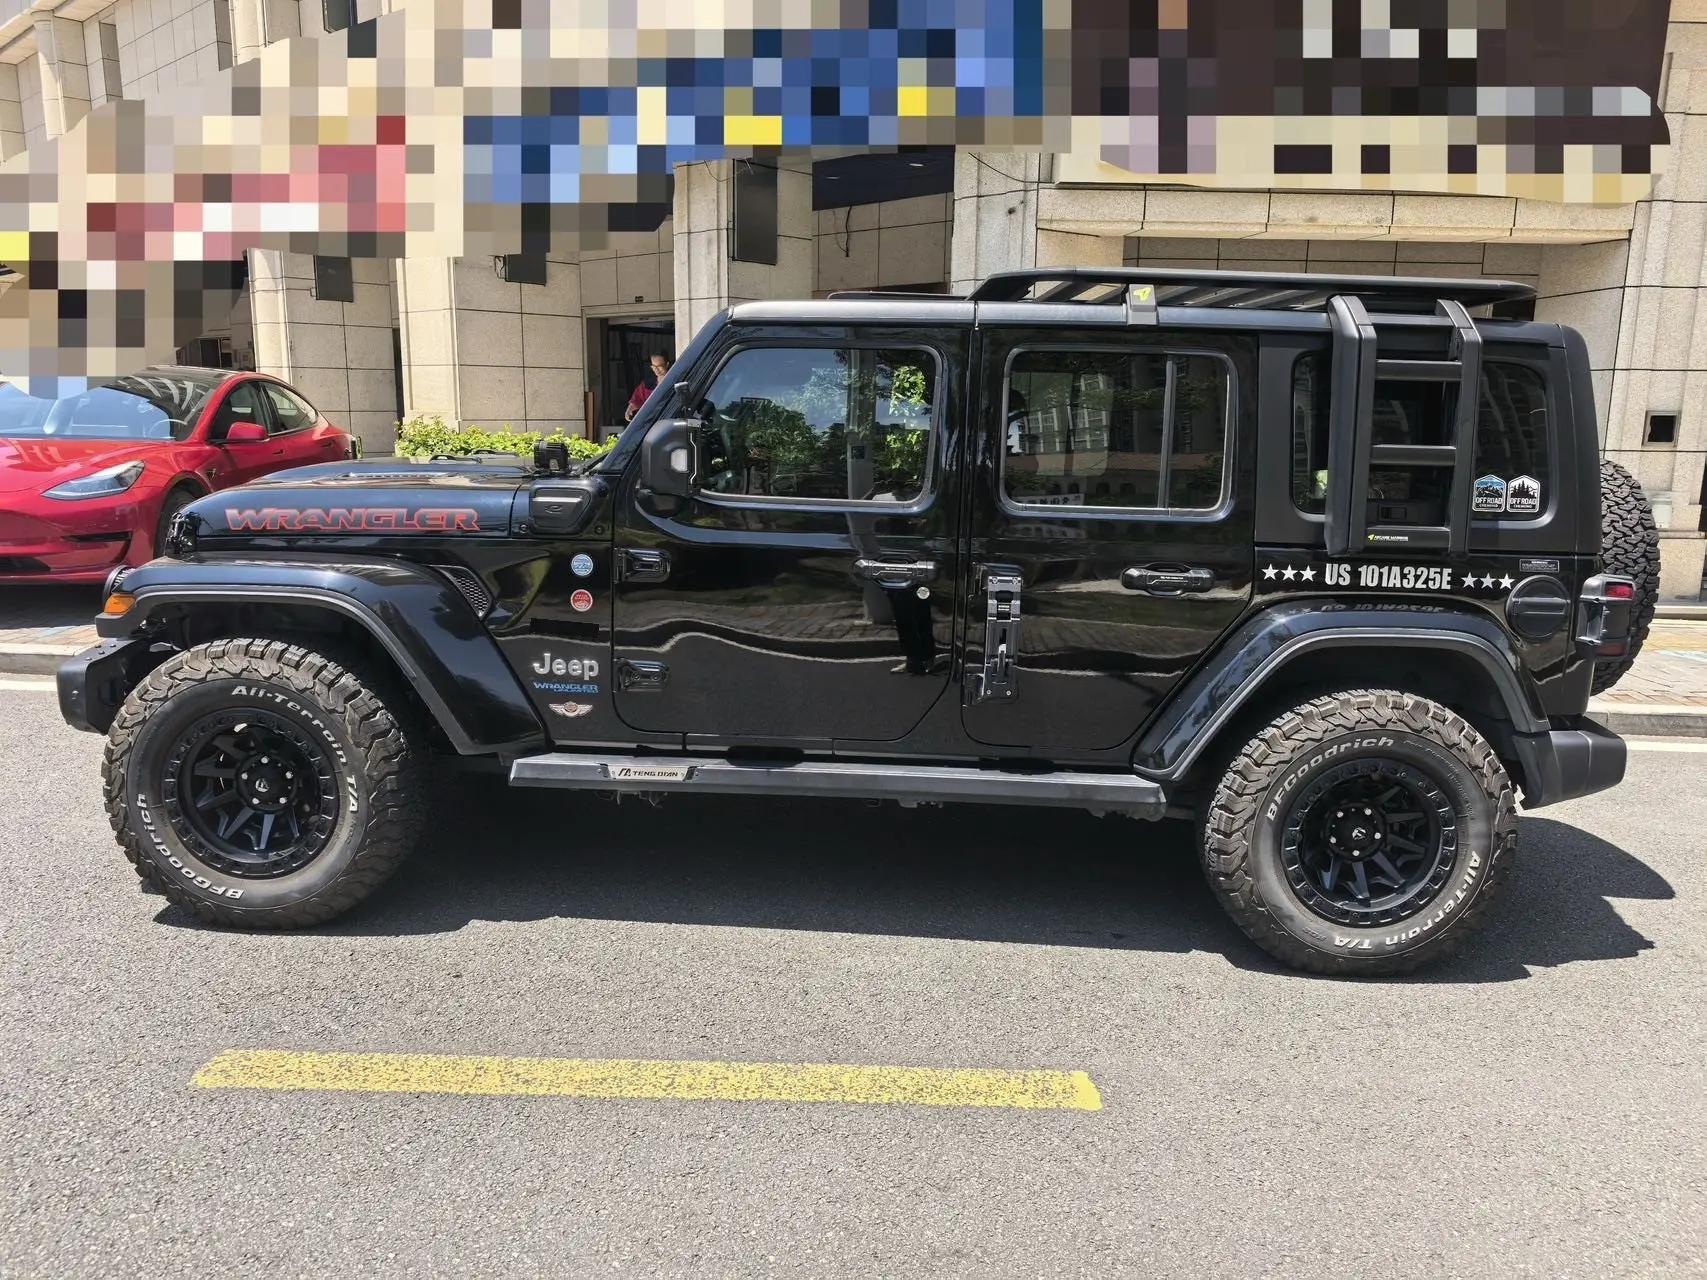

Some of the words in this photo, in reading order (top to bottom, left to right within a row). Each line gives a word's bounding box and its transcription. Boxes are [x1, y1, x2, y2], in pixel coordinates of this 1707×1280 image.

[224, 508, 480, 531] WRANGLER
[1325, 563, 1351, 586] US
[1358, 564, 1452, 590] 101A325E
[533, 653, 599, 681] Jeep
[533, 682, 599, 690] WRANGLER
[231, 685, 348, 765] All-Terrain
[346, 774, 359, 812] T/A
[1265, 736, 1395, 821] BFGoodrich
[136, 793, 245, 900] BFGoodrich
[1385, 851, 1482, 947] All-Terrain
[1334, 935, 1373, 949] T/A
